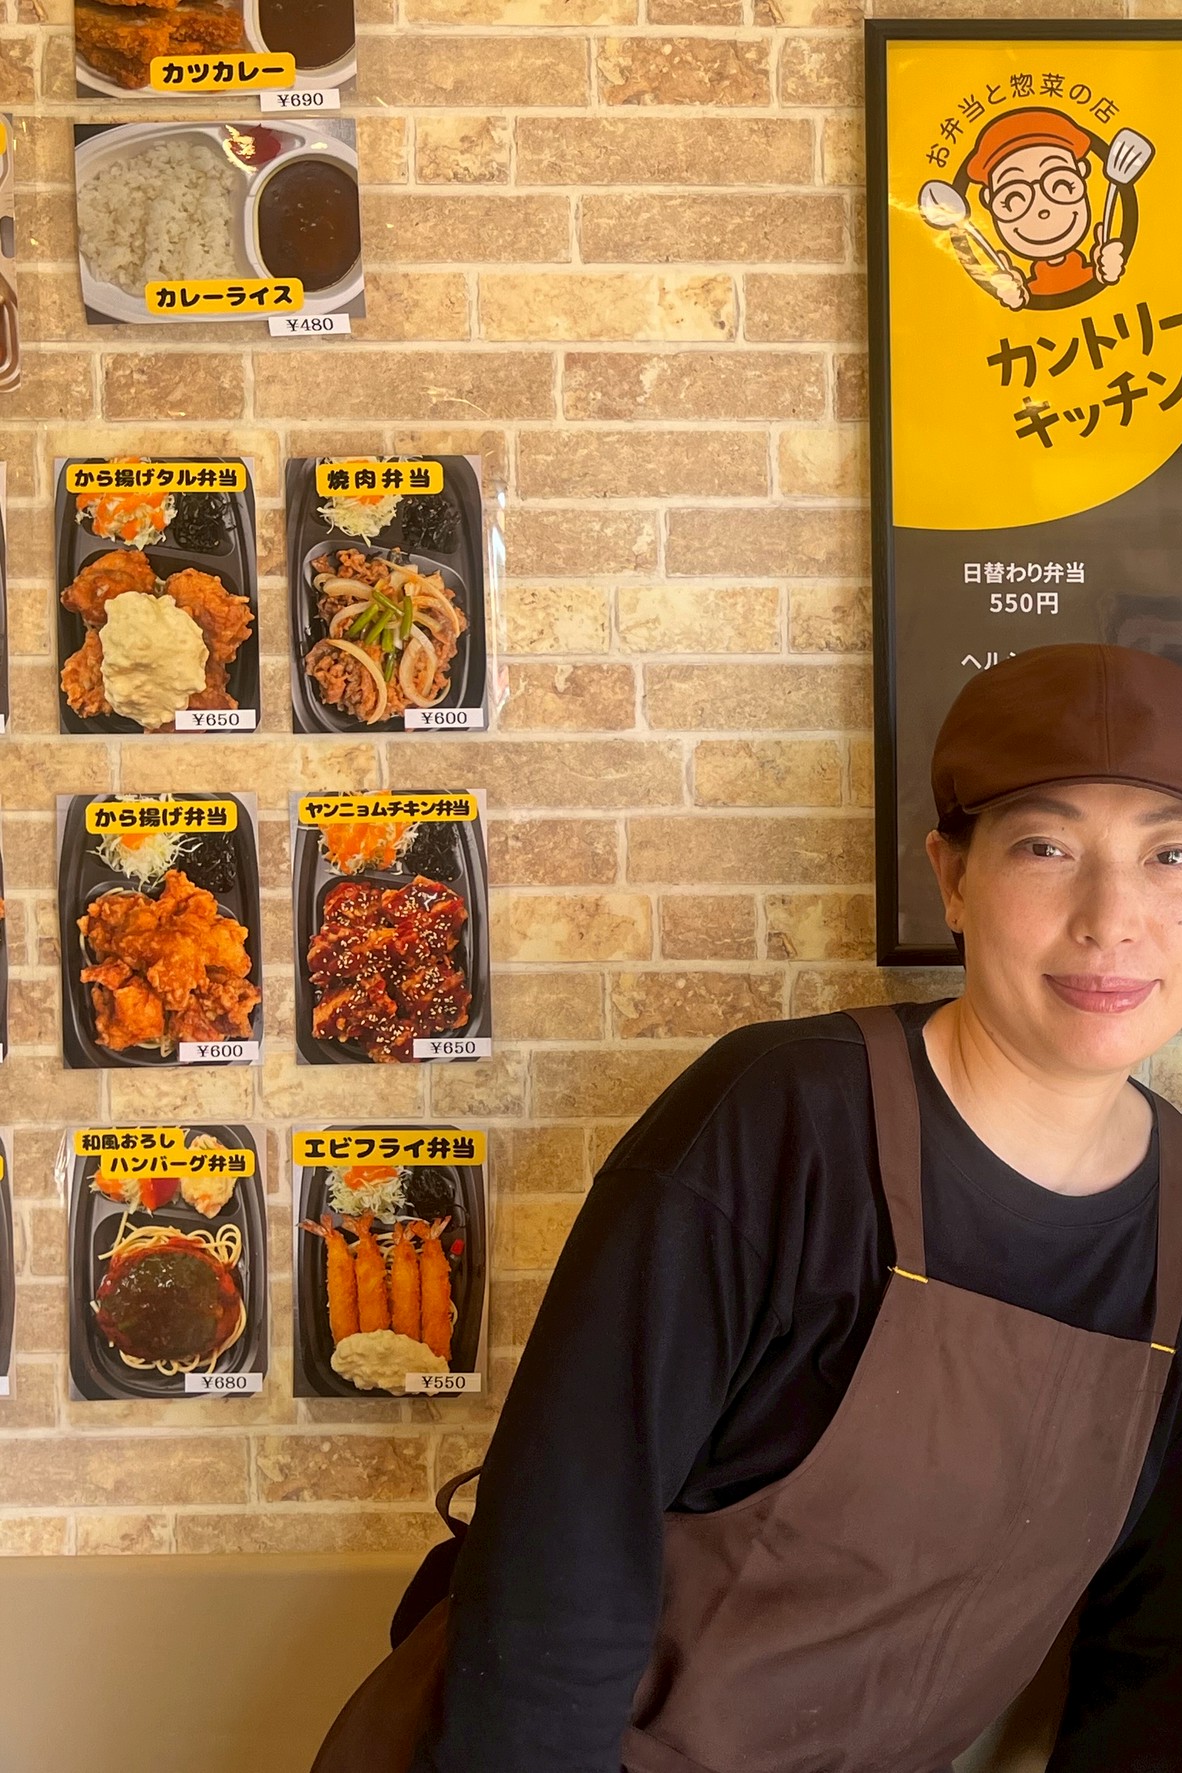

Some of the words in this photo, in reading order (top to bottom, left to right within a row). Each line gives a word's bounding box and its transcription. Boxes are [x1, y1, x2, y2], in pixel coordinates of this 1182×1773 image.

[163, 61, 284, 83] カツカレー
[277, 92, 324, 109] ¥690
[926, 73, 1119, 167] お弁当と惣菜の店
[156, 286, 292, 307] カレーライス
[286, 317, 334, 333] ¥480
[75, 468, 236, 487] から揚げタル弁当
[328, 468, 429, 490] 焼肉弁当
[965, 562, 1084, 583] 日替わり弁当
[990, 593, 1058, 614] 550円
[961, 651, 1016, 670] ヘル
[192, 711, 240, 727] ¥650
[421, 710, 468, 725] ¥600
[95, 807, 226, 827] から揚げ弁当
[305, 800, 470, 819] ヤンニョムチキン弁当
[196, 1041, 244, 1058] ¥600
[430, 1039, 476, 1055] ¥650
[81, 1134, 175, 1155] 和風おろし
[305, 1137, 474, 1159] エビフライ弁当
[110, 1152, 247, 1173] ハンバーグ弁当
[202, 1375, 247, 1390] ¥680
[421, 1374, 466, 1390] ¥550
